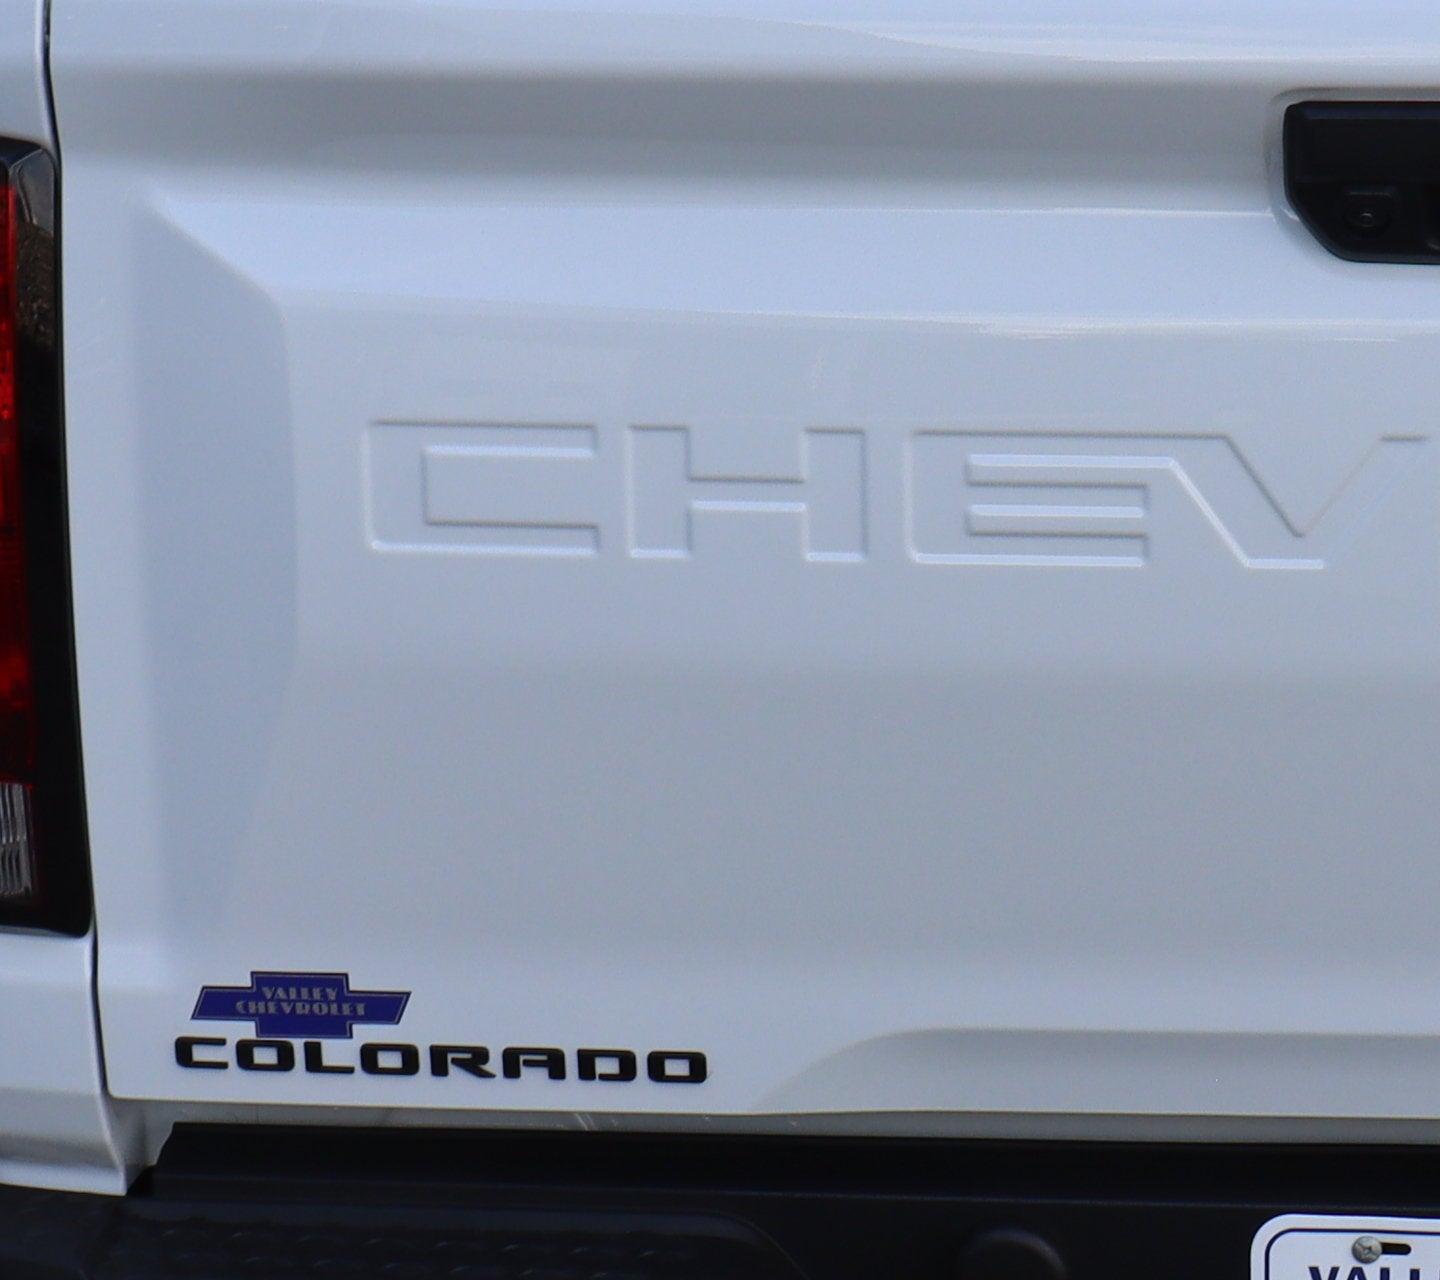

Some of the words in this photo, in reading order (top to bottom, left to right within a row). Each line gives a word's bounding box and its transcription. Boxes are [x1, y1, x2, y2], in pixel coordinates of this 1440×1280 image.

[261, 986, 338, 1001] VALLEY
[235, 1000, 367, 1016] CHEVROLET
[173, 1035, 710, 1085] COLORADO
